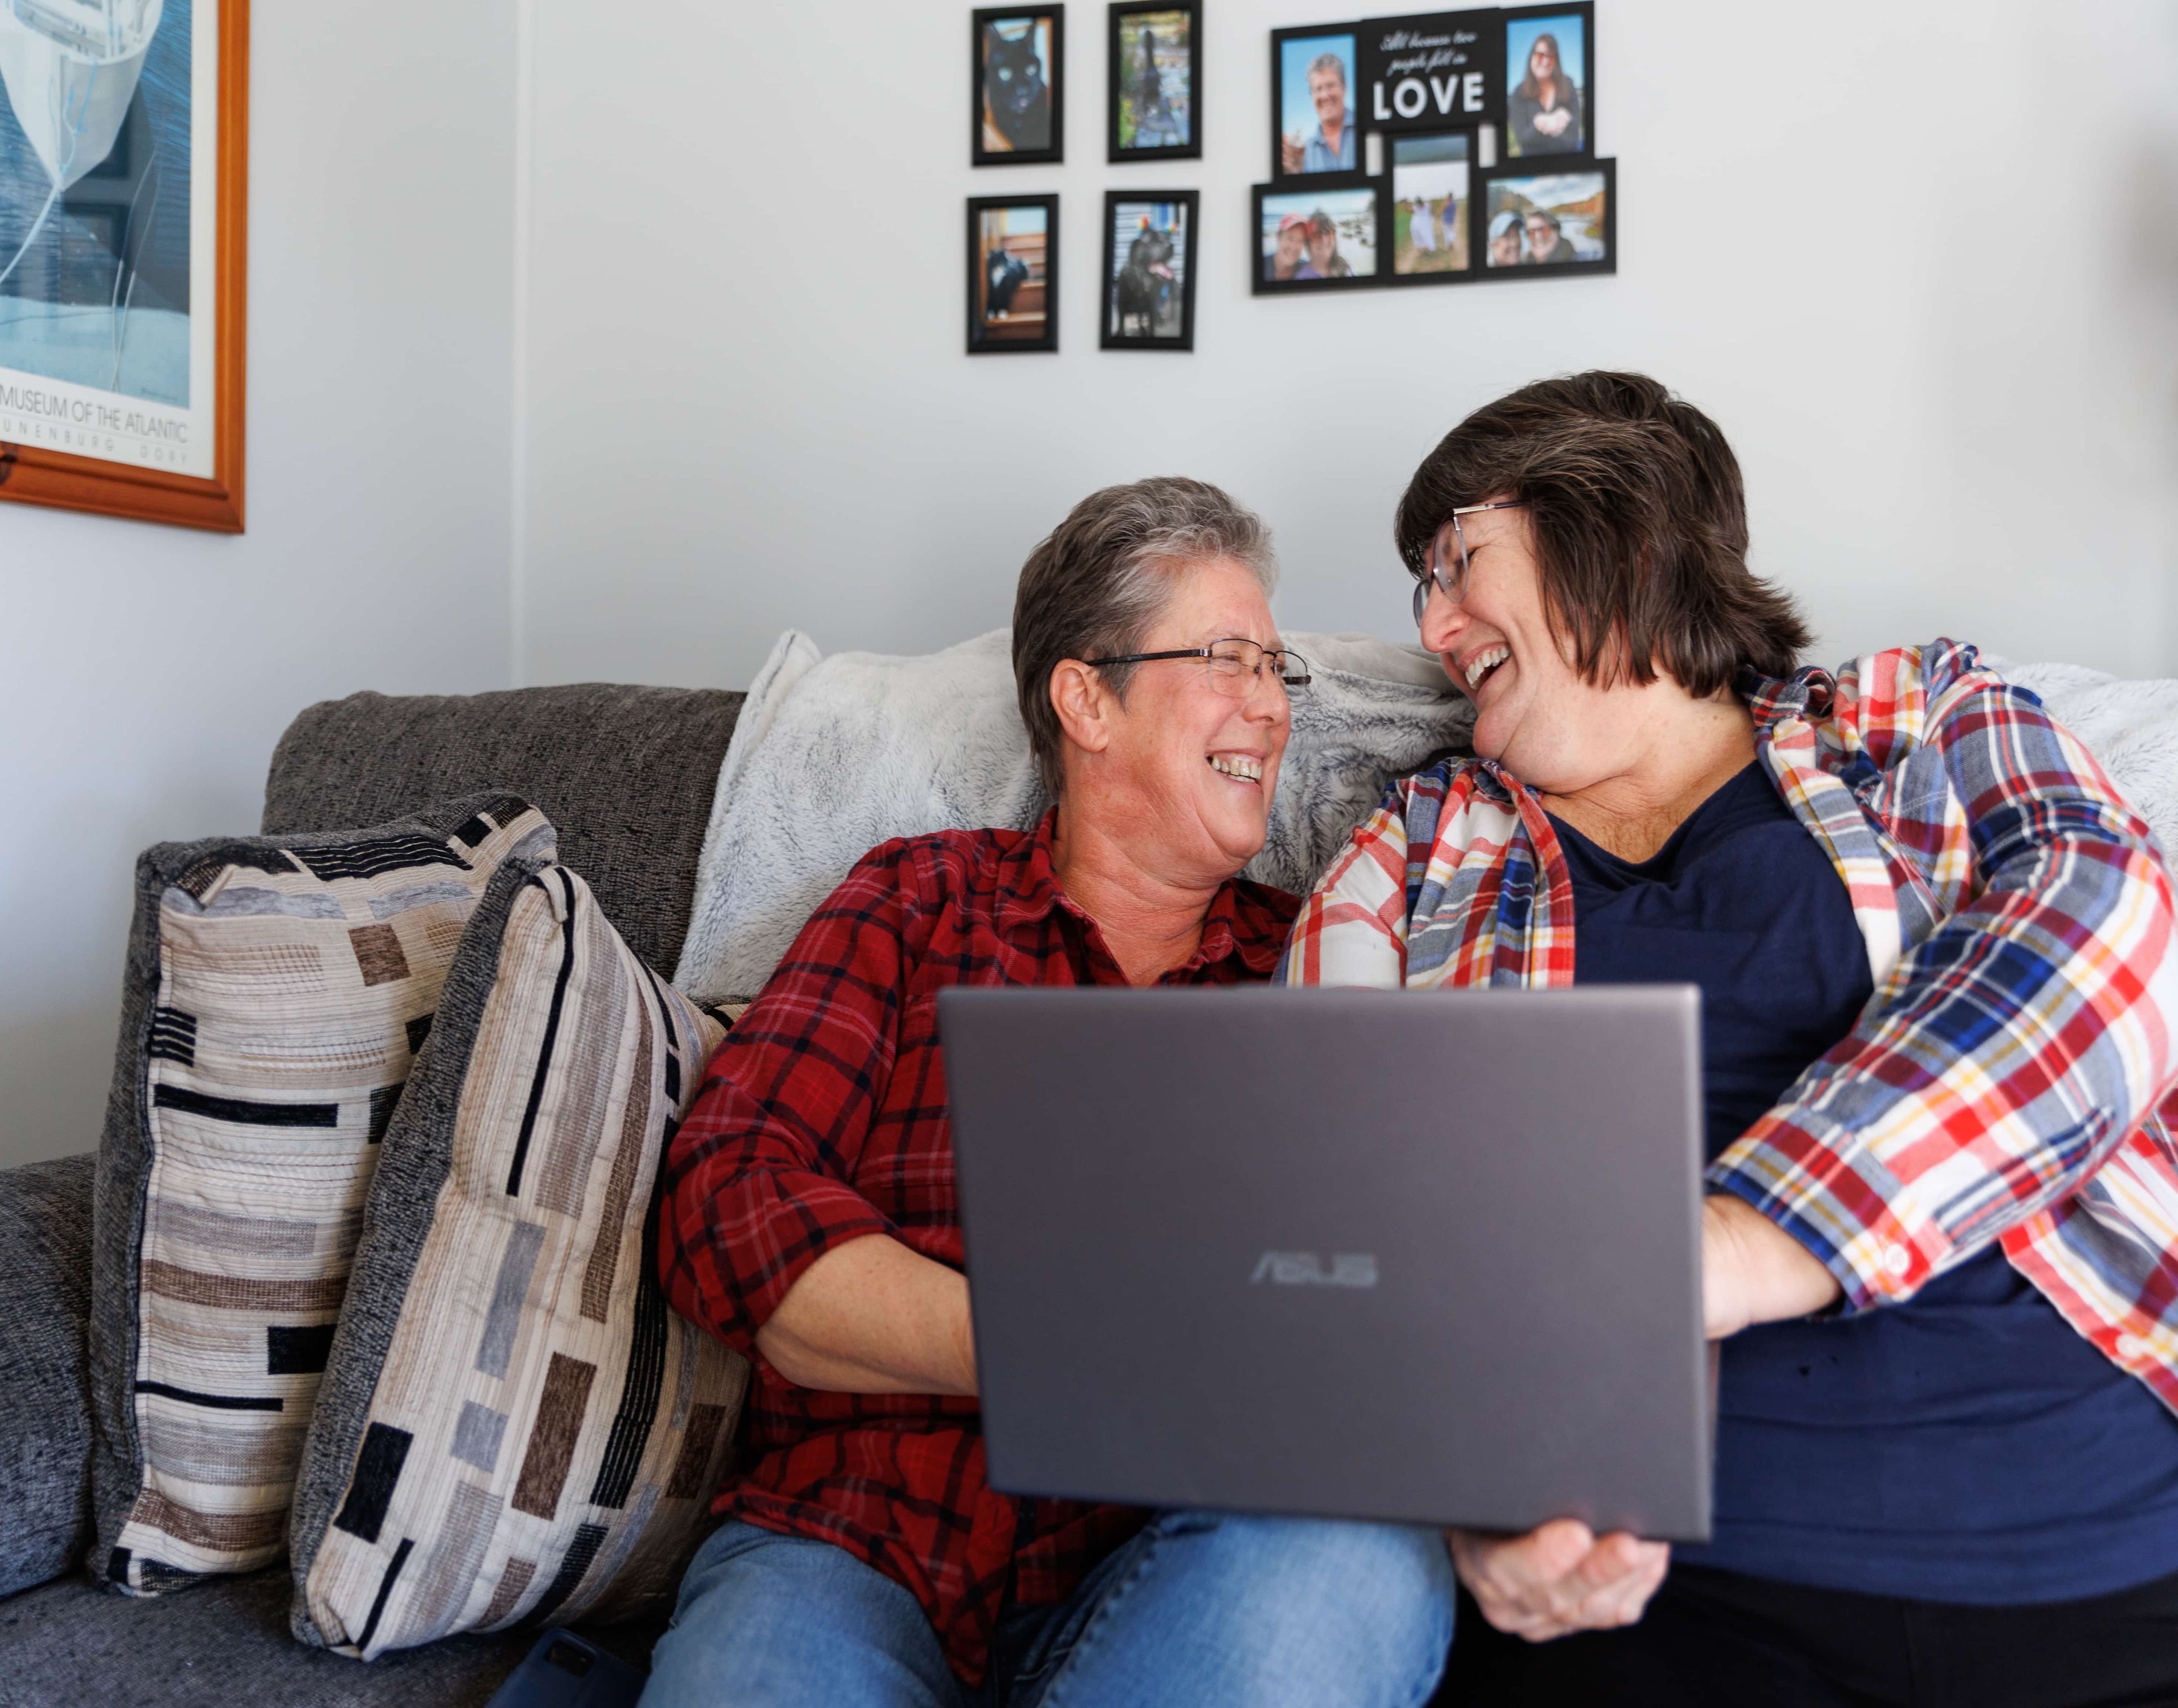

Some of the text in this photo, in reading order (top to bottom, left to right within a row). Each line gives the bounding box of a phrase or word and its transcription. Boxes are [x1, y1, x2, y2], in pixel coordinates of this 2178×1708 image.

[1373, 71, 1484, 120] LOVE
[0, 384, 189, 444] MUSEUM OF THE ATLANTIC
[3, 418, 114, 452] UNENBURG
